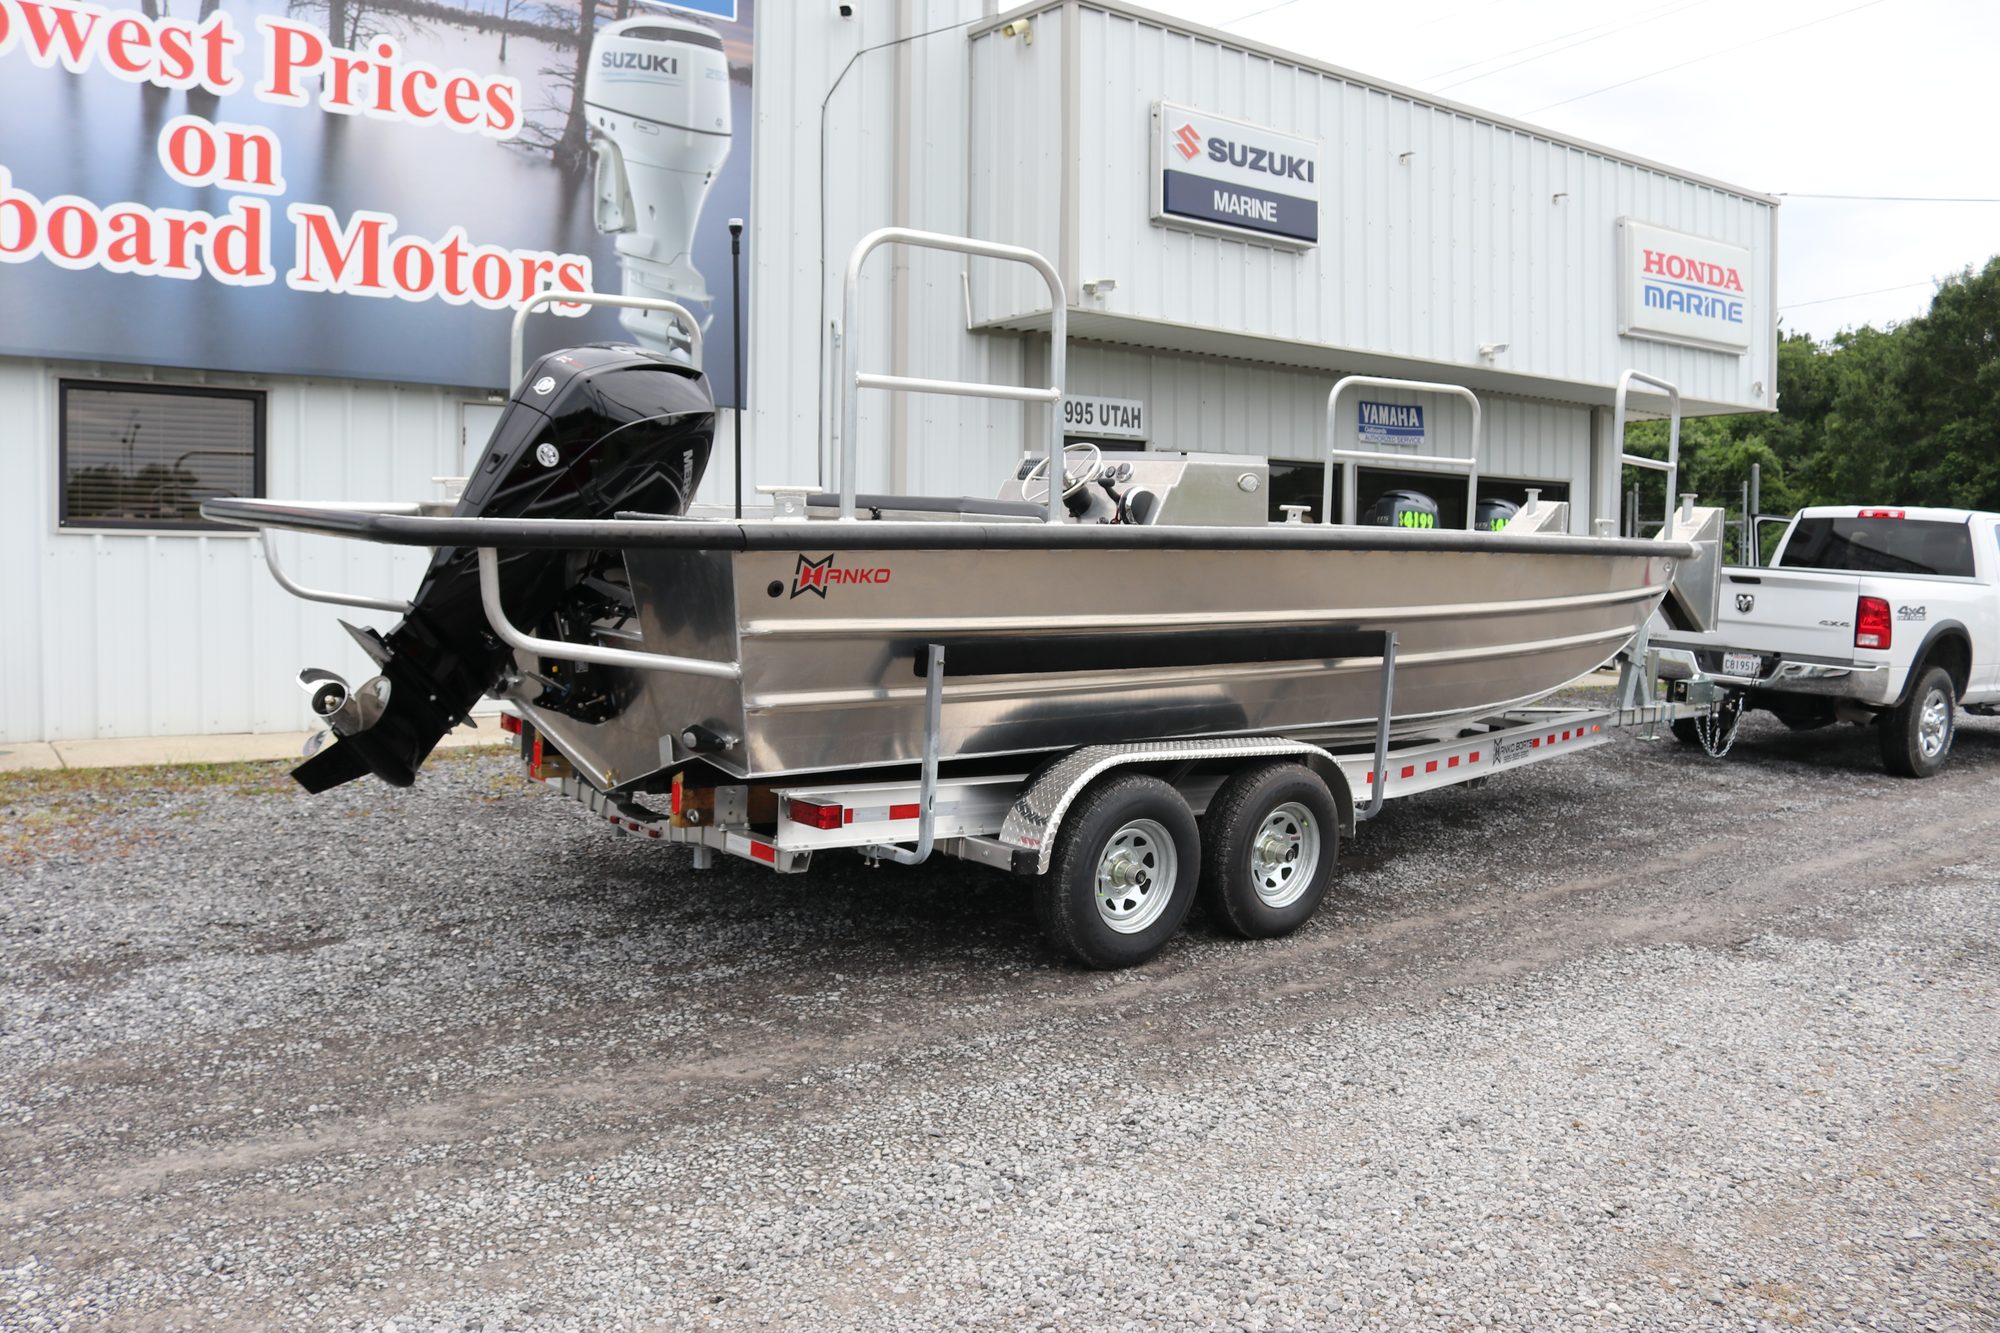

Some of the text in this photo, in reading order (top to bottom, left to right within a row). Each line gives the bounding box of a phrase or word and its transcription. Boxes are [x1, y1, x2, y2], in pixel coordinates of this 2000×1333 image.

[0, 0, 516, 131] west Prices
[601, 51, 678, 75] SUZUKI
[168, 125, 277, 187] on
[1207, 136, 1315, 184] SUZUKI
[1213, 189, 1278, 223] MARINE
[296, 211, 587, 309] Motors
[1643, 249, 1744, 292] HONDA
[1644, 284, 1744, 324] MARINE
[1099, 403, 1142, 429] UTAH
[1362, 403, 1420, 427] YAMAHA
